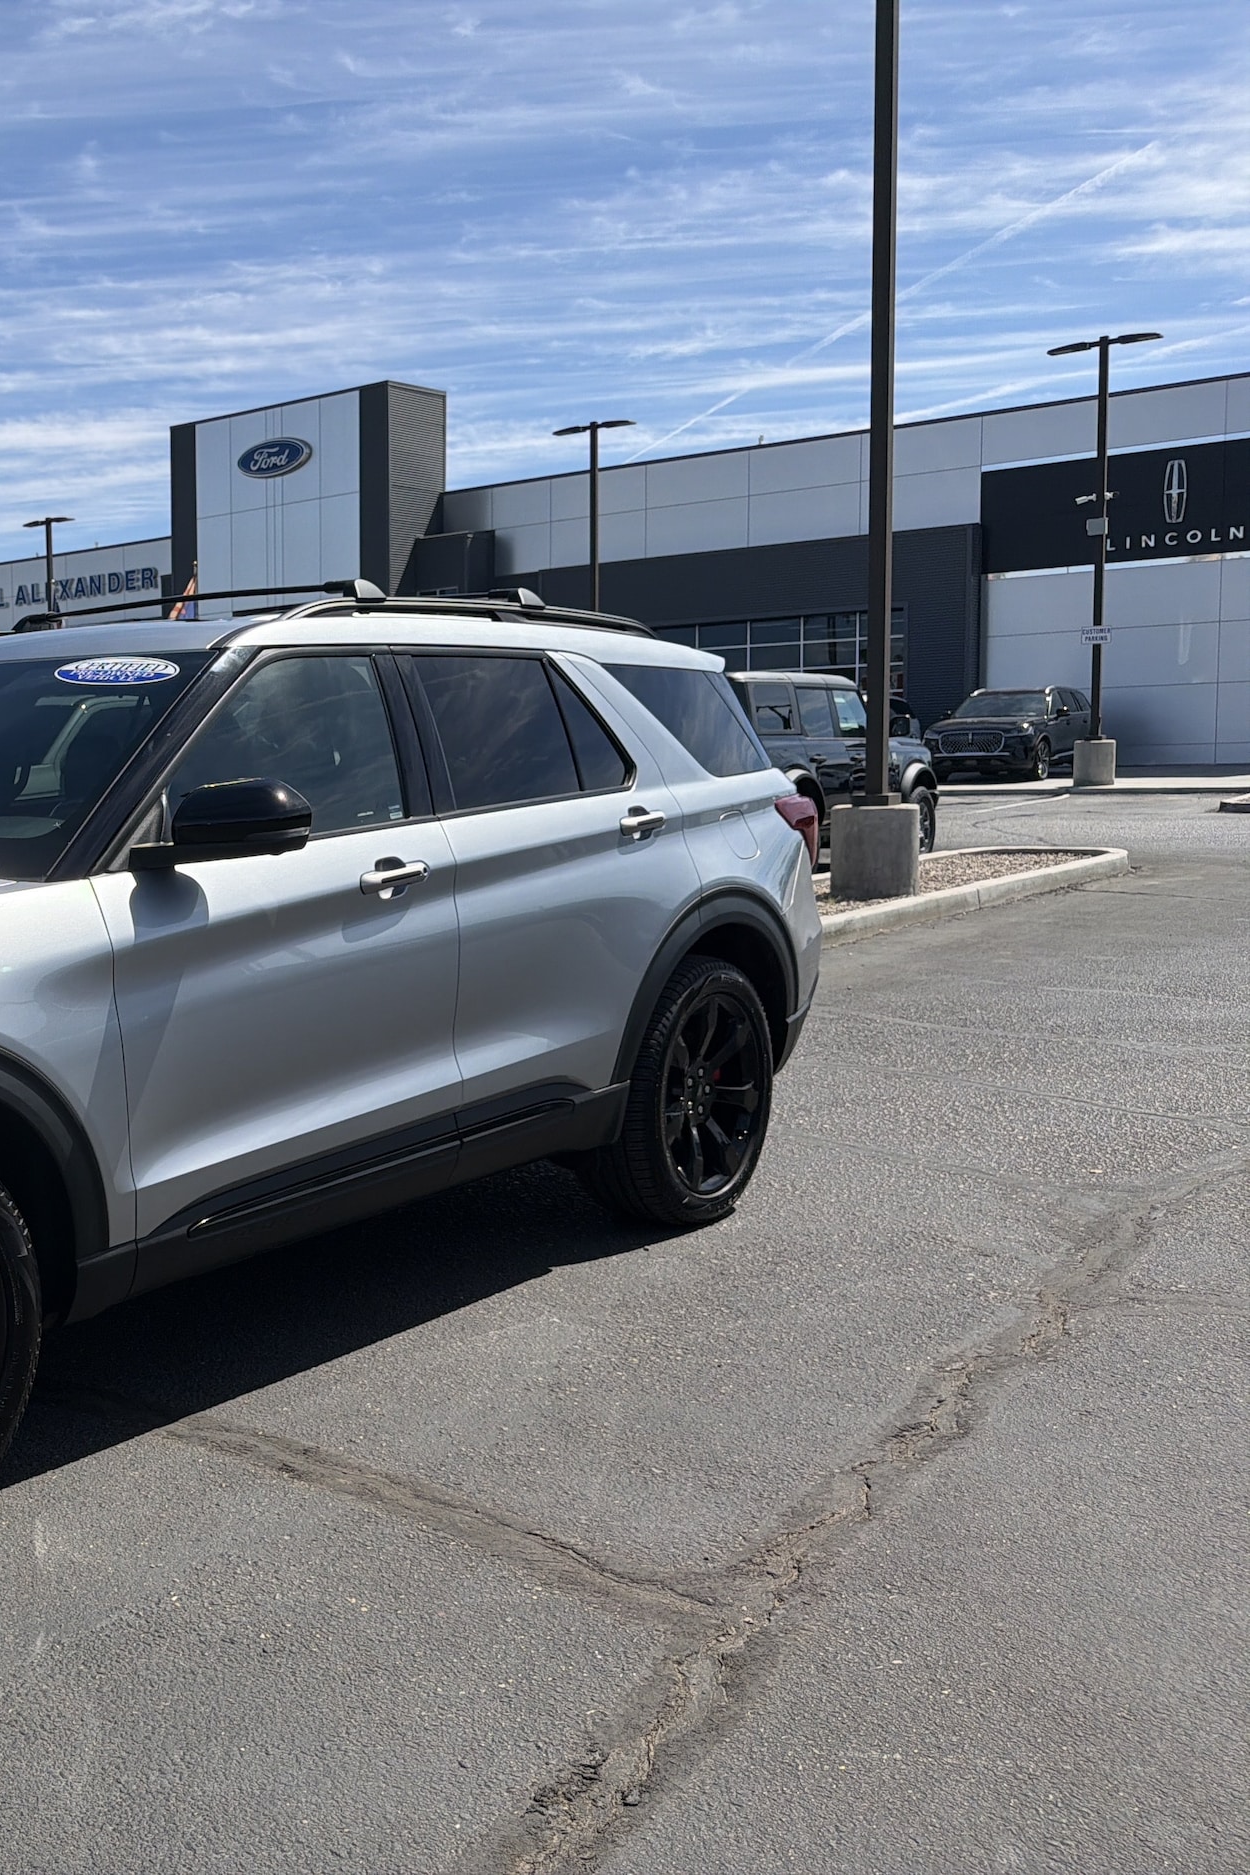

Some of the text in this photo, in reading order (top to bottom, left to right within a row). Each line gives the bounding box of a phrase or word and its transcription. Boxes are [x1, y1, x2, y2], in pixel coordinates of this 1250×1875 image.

[250, 446, 290, 471] Ford
[1106, 526, 1244, 551] LINCOLN
[15, 567, 158, 606] ALXANDER
[75, 662, 168, 671] CERTIFIED
[77, 674, 137, 682] VEHICLE
